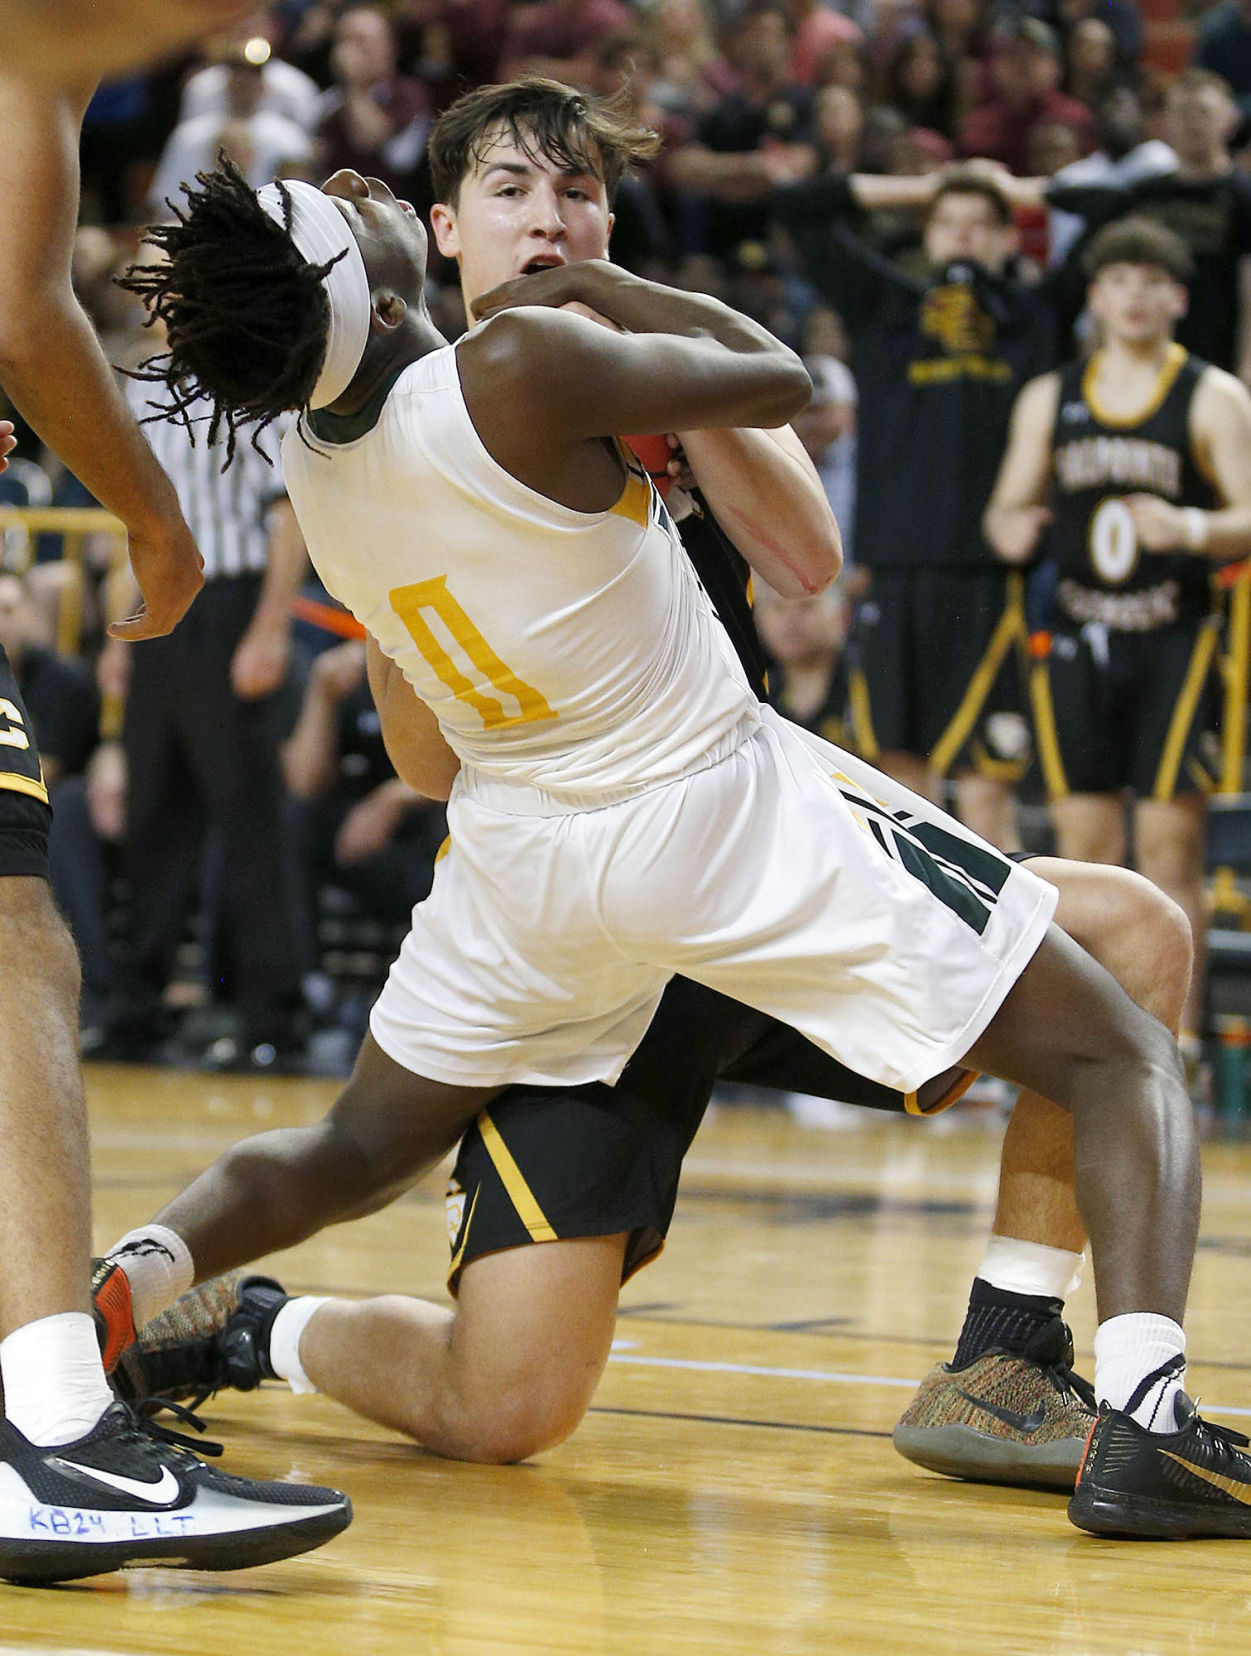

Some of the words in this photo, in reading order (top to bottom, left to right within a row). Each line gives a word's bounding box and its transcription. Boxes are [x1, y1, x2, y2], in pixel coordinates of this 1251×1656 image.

[1090, 495, 1137, 582] 0
[389, 575, 559, 730] 0
[29, 1507, 105, 1535] KB24
